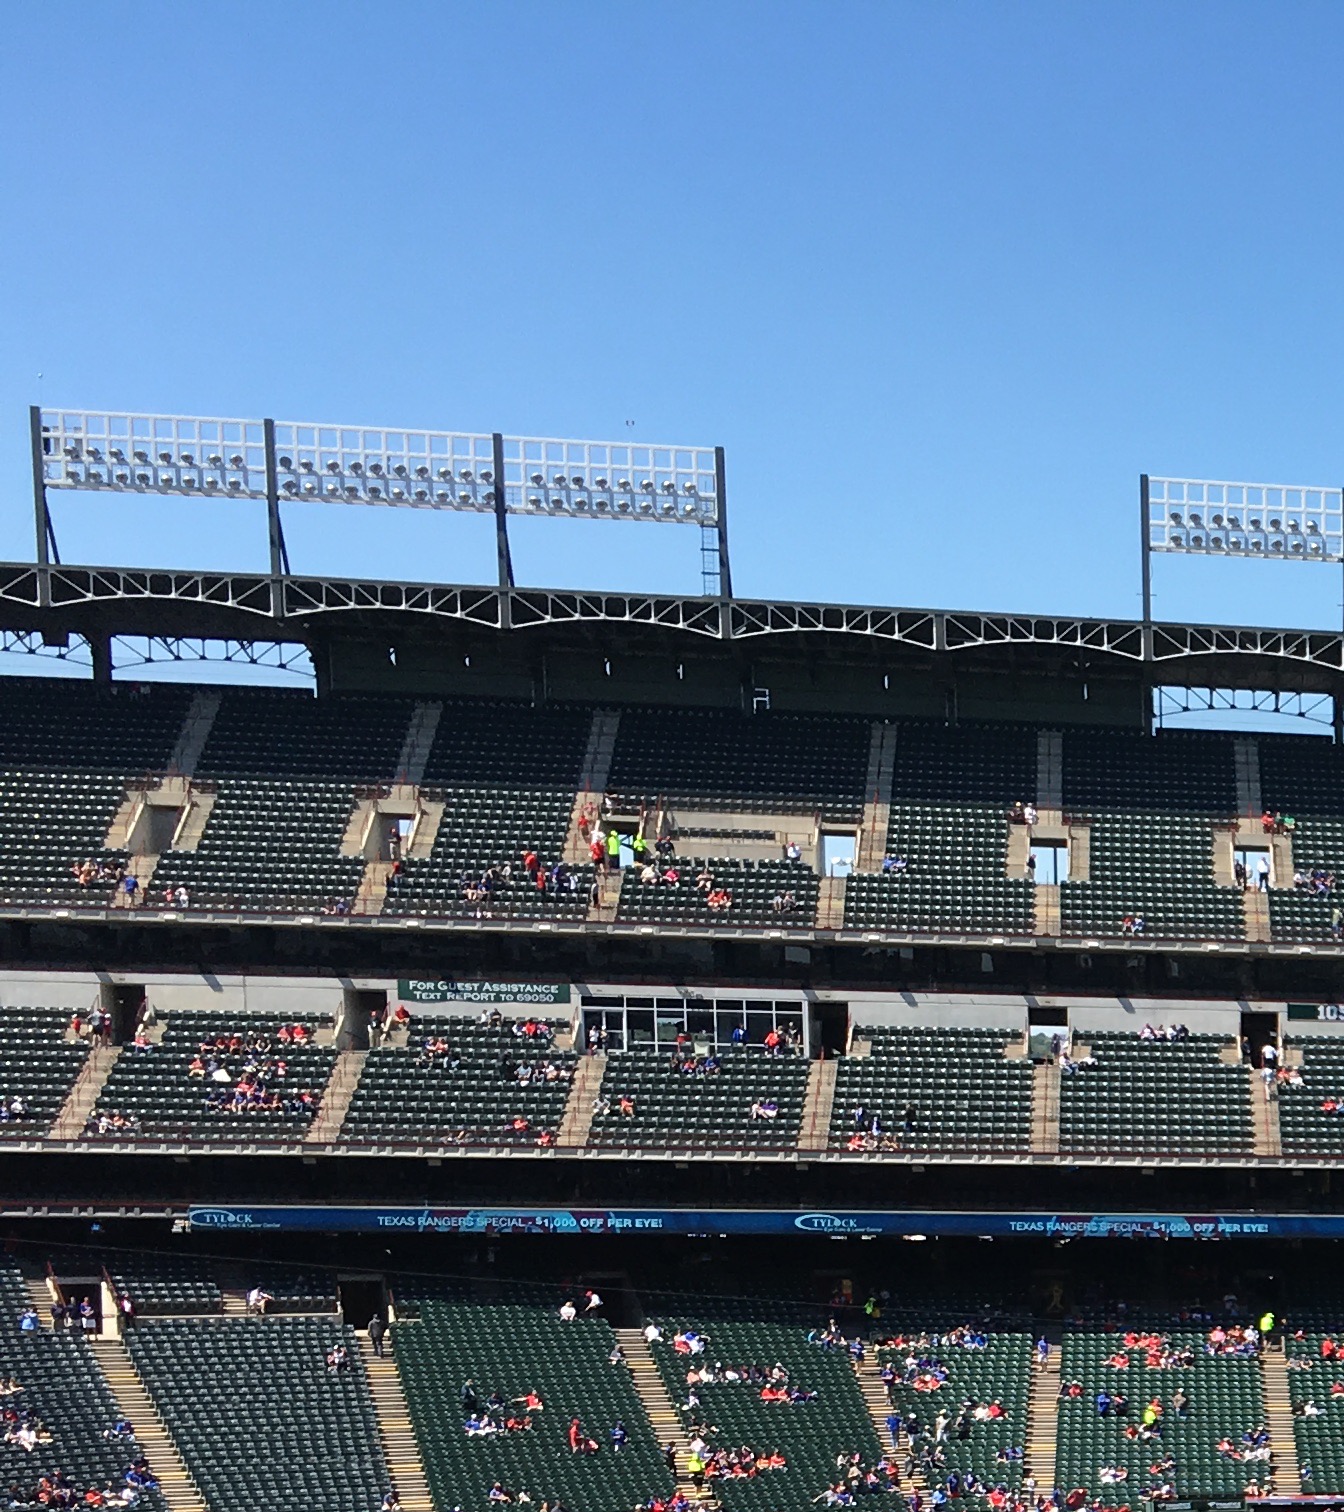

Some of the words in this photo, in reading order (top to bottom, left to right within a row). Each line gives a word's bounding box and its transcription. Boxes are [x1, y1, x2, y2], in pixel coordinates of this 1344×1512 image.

[409, 981, 434, 990] FOR
[437, 982, 479, 991] GUEST
[482, 982, 559, 993] ASSISTANCE
[413, 991, 442, 1000] TEXT
[447, 992, 497, 1001] REPORT
[517, 993, 554, 1002] 69050
[377, 1216, 415, 1226] TEXAS
[418, 1216, 474, 1227] RANGERS
[476, 1217, 524, 1227] SPECIAL
[535, 1216, 576, 1229] $1,000
[580, 1218, 603, 1227] OFF
[607, 1218, 632, 1228] PER
[635, 1219, 663, 1228] EYE!
[1010, 1222, 1044, 1231] TEXAS
[1047, 1222, 1097, 1231] RANGERS
[1100, 1222, 1143, 1232] SPECIAL
[1153, 1221, 1191, 1233] $1,000
[1194, 1224, 1215, 1232] OFF
[1219, 1224, 1241, 1232] PER
